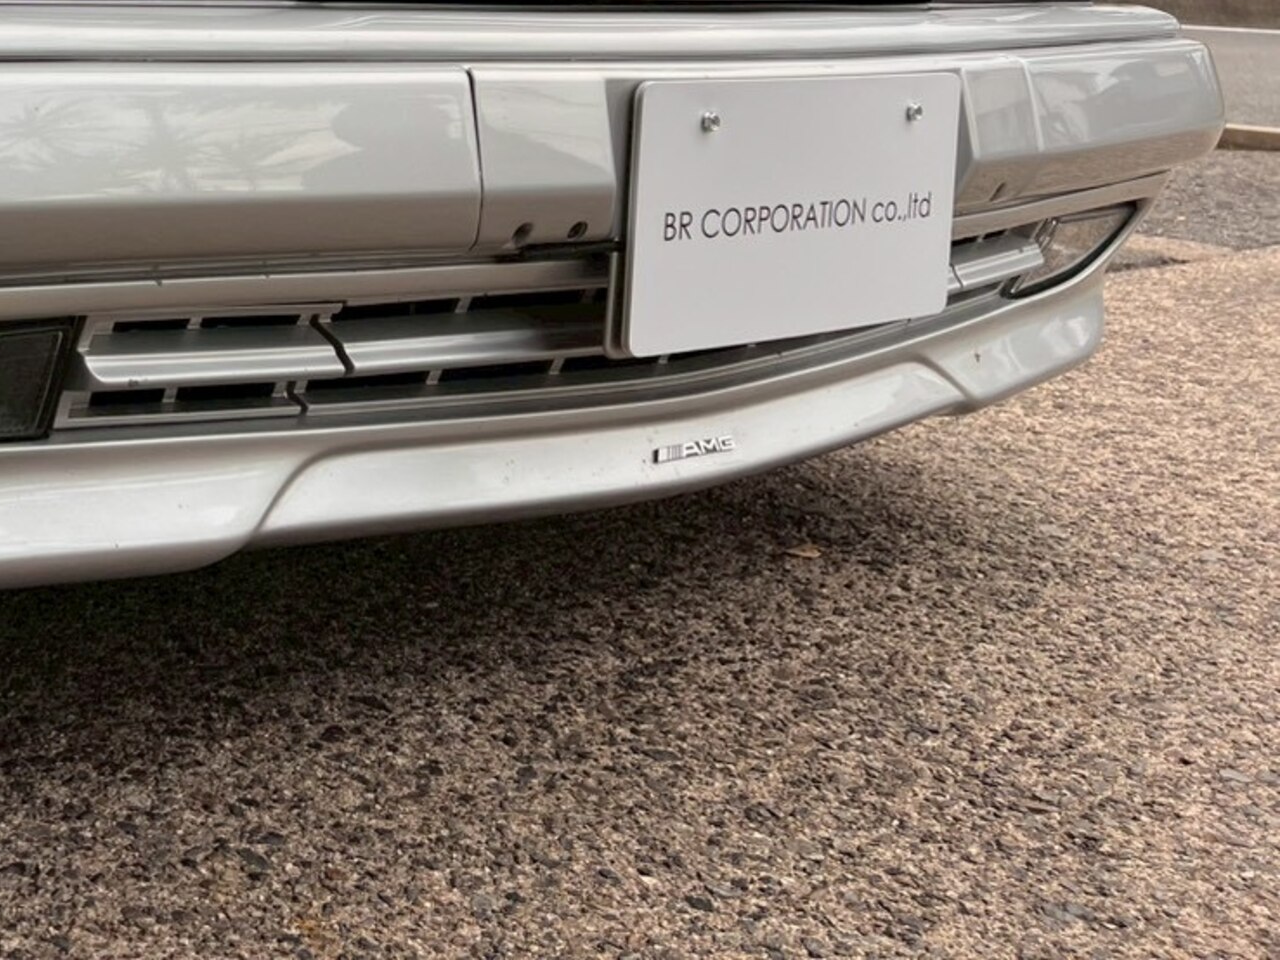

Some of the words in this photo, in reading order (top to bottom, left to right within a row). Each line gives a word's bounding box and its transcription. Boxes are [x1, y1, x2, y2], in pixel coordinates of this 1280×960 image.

[664, 211, 693, 241] BR
[701, 198, 867, 238] CORPORATION
[682, 435, 736, 458] AMG
